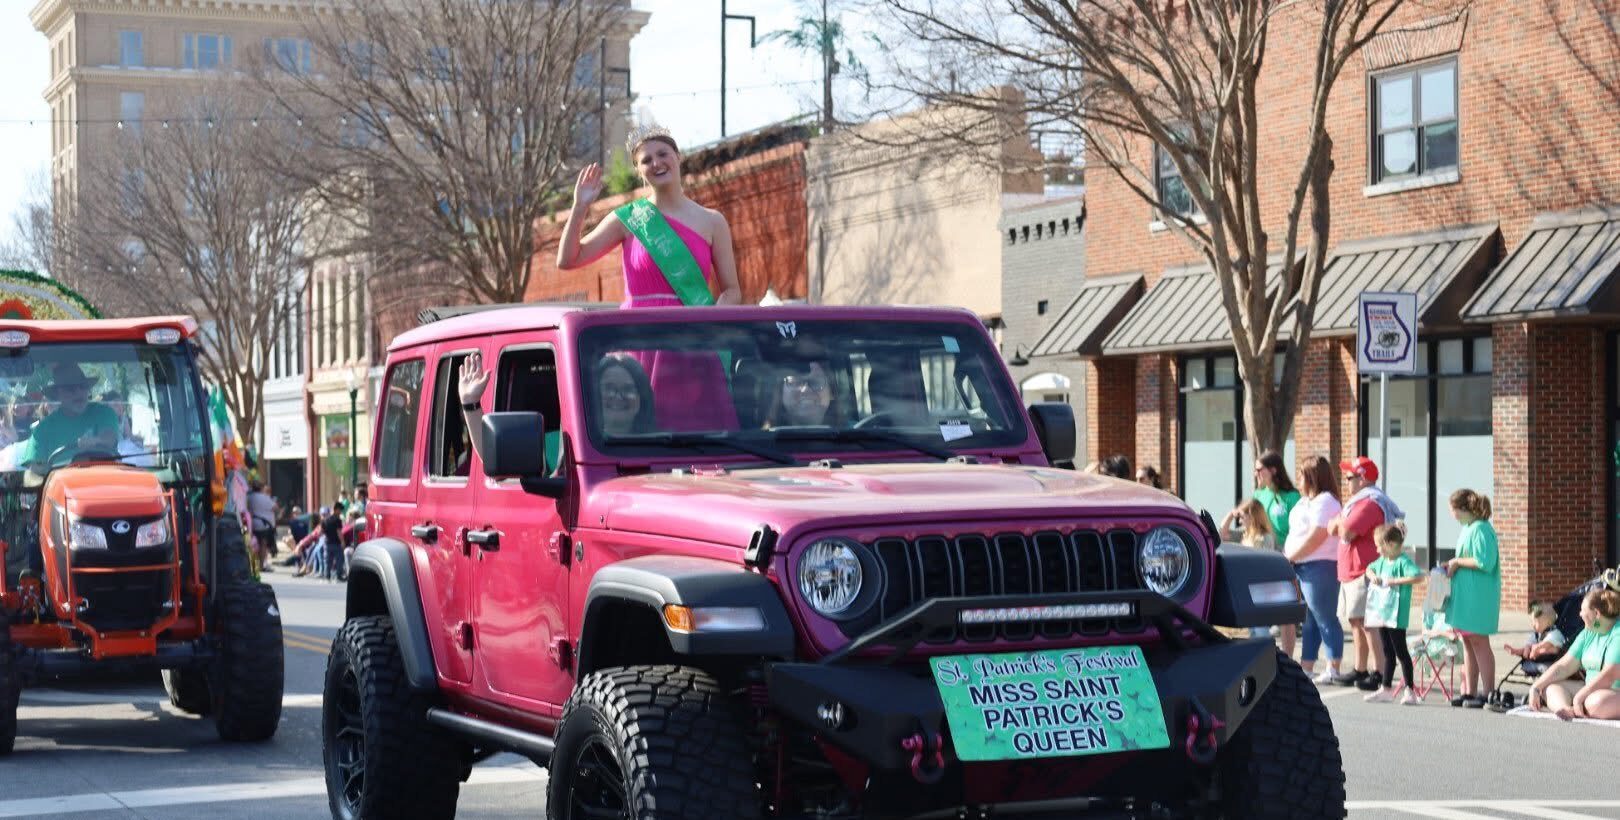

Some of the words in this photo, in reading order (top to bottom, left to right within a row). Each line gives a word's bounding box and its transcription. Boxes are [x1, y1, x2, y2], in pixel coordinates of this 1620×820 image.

[937, 660, 969, 684] St.
[973, 655, 1056, 679] Patrick's
[1061, 650, 1140, 675] Festival
[969, 682, 1038, 705] MISS
[1045, 676, 1121, 700] SAINT
[983, 701, 1124, 729] PATRICK'S
[1013, 728, 1107, 753] QUEEN
